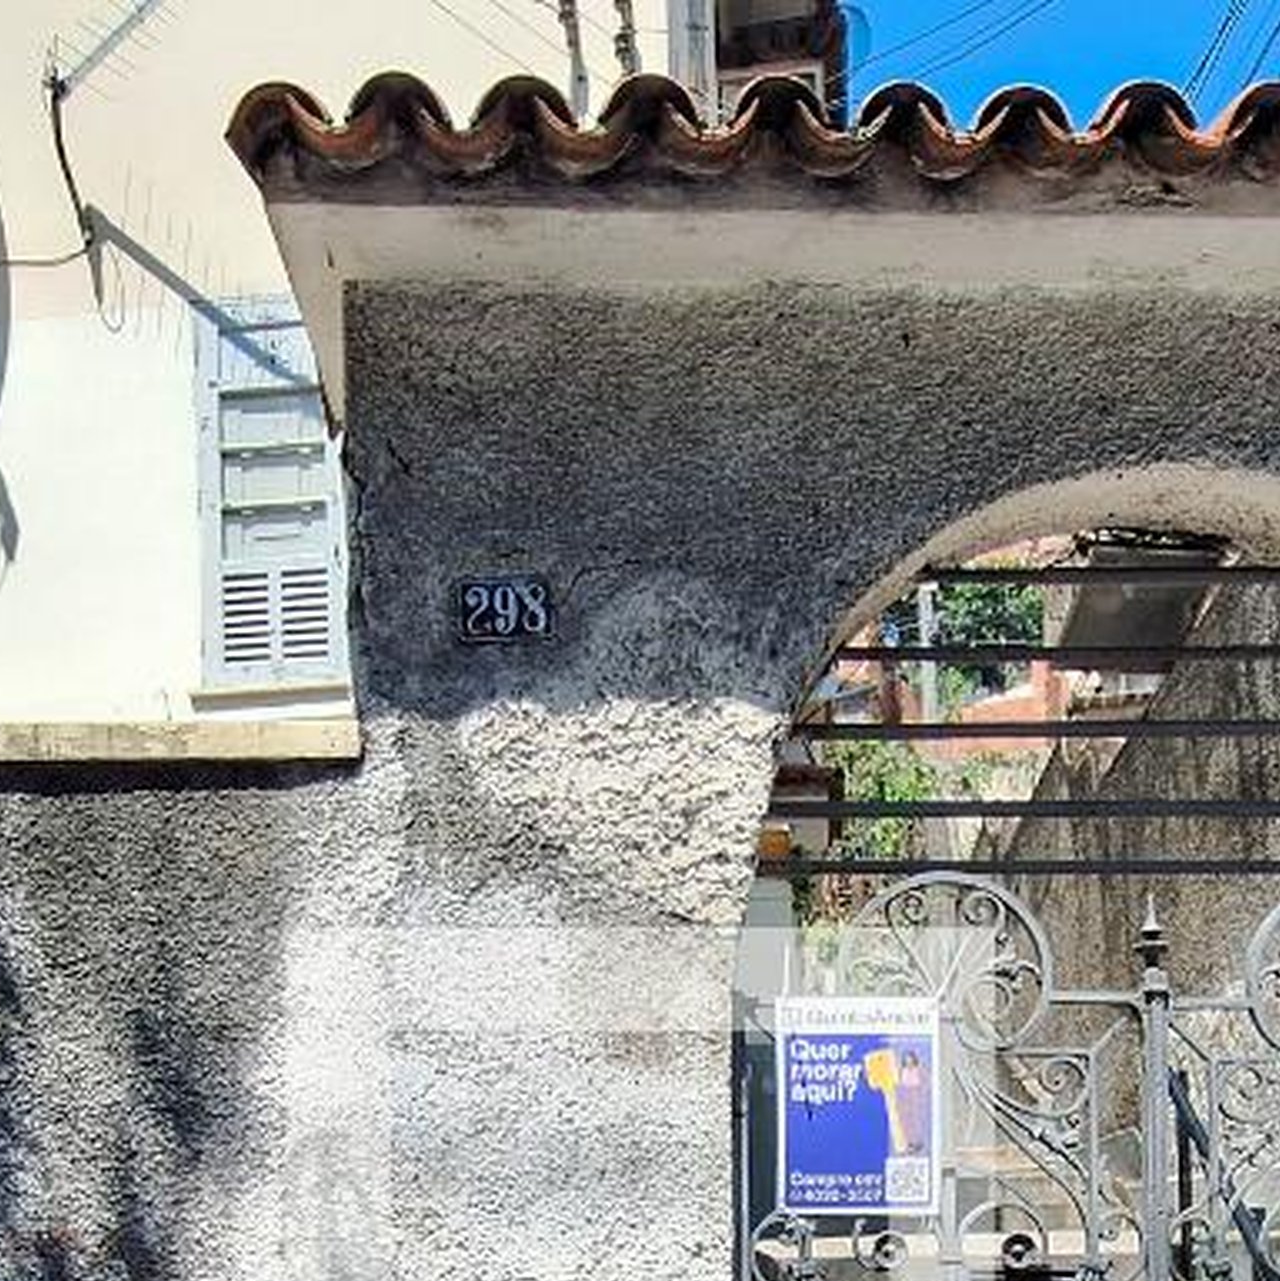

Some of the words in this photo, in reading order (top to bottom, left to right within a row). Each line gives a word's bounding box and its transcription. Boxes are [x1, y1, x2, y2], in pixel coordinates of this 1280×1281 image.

[464, 582, 547, 635] 298
[790, 1040, 853, 1061] Quer
[791, 1064, 863, 1081] morar
[791, 1080, 856, 1105] aqui?
